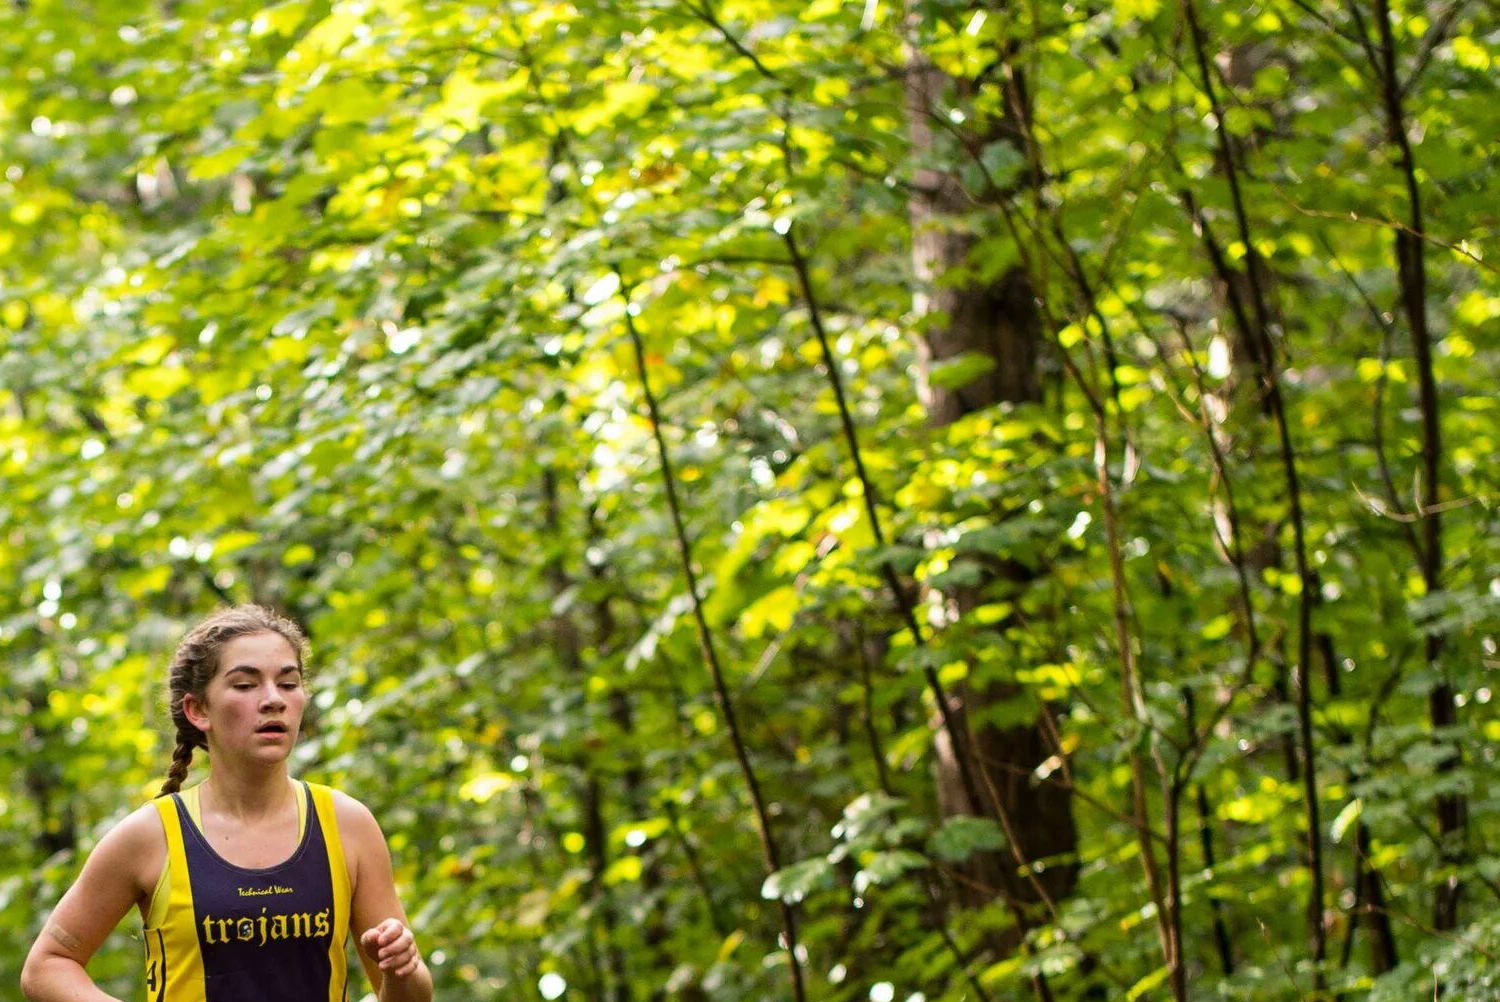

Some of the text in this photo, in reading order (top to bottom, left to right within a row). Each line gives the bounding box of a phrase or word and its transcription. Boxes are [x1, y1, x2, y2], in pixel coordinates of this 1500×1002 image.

[237, 885, 293, 897] Technical Wear
[202, 907, 330, 947] trojans
